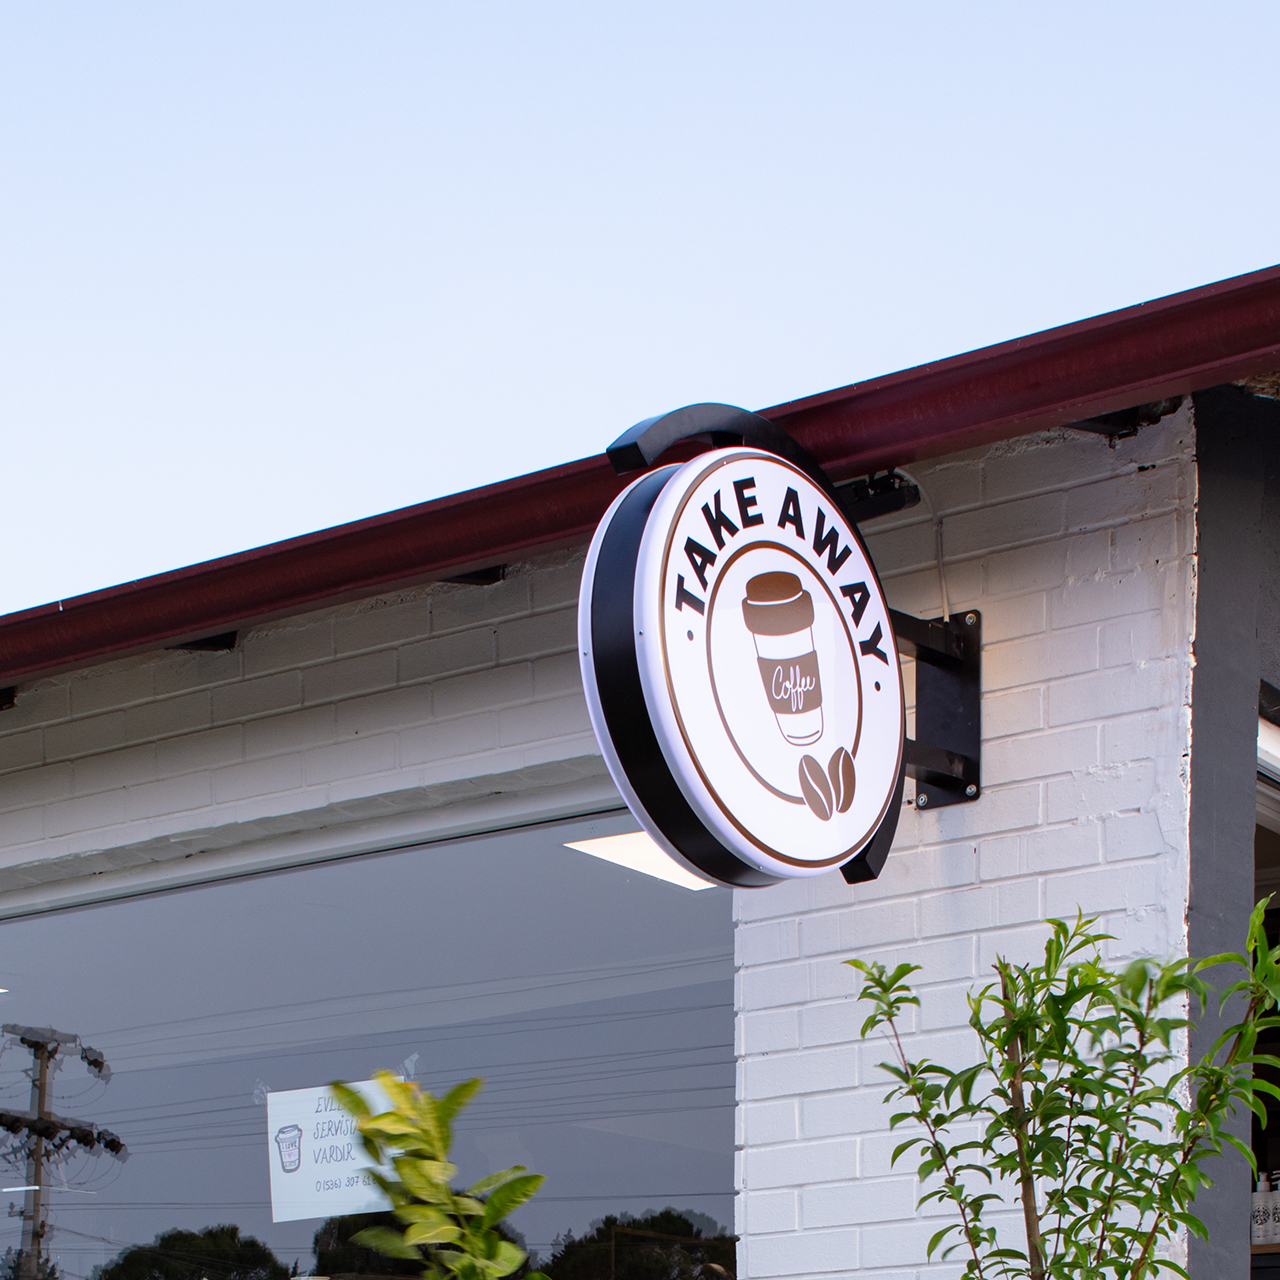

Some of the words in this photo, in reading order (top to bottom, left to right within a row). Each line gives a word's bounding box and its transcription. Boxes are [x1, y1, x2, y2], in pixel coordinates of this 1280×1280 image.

[675, 477, 764, 617] TAKE
[777, 486, 890, 666] AWAY
[771, 664, 816, 713] Coffee
[313, 1142, 356, 1165] VARDIR
[315, 1178, 342, 1192] 0(536)
[345, 1176, 360, 1188] 307
